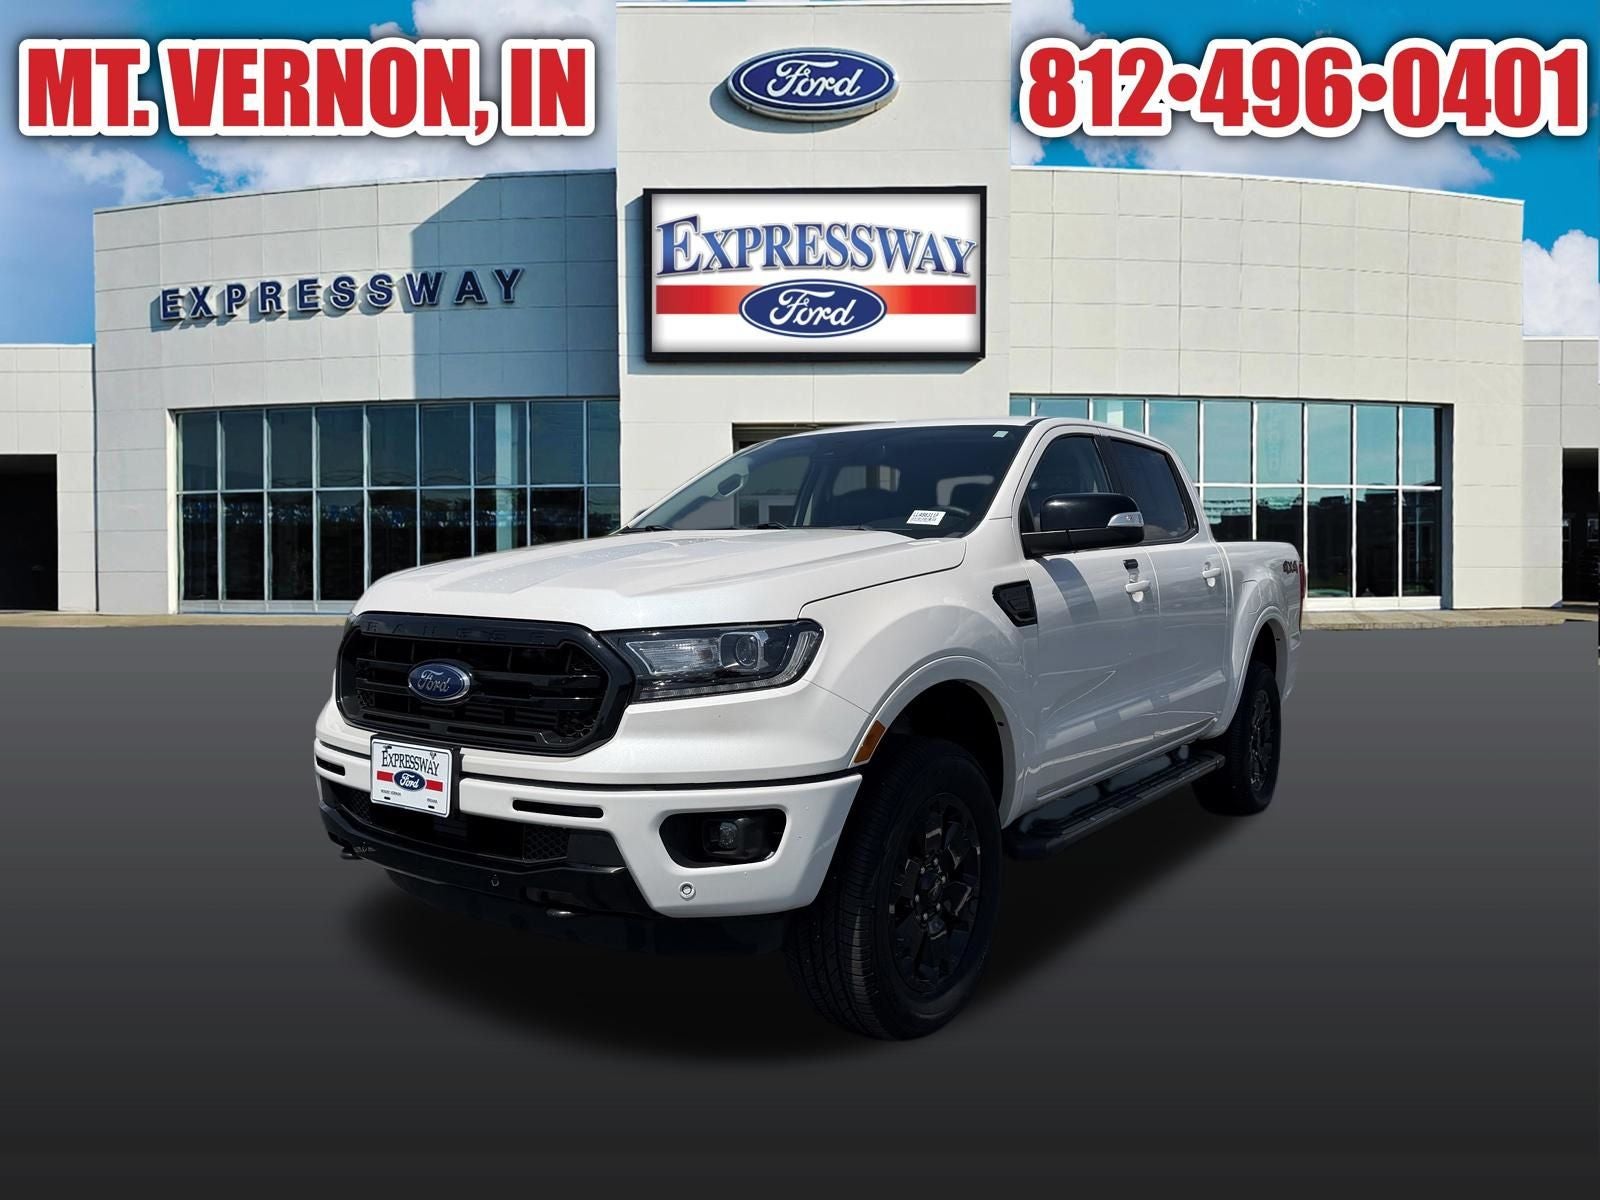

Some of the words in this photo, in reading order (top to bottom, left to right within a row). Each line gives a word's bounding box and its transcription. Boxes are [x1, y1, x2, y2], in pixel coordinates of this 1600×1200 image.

[766, 59, 864, 98] Ford
[655, 214, 977, 278] EXPRESSWAY
[160, 268, 525, 321] EXPRESSWAY
[768, 288, 857, 326] Ford
[416, 669, 451, 693] Ford
[381, 750, 440, 777] EXPRESSWAY
[399, 772, 419, 789] Ford
